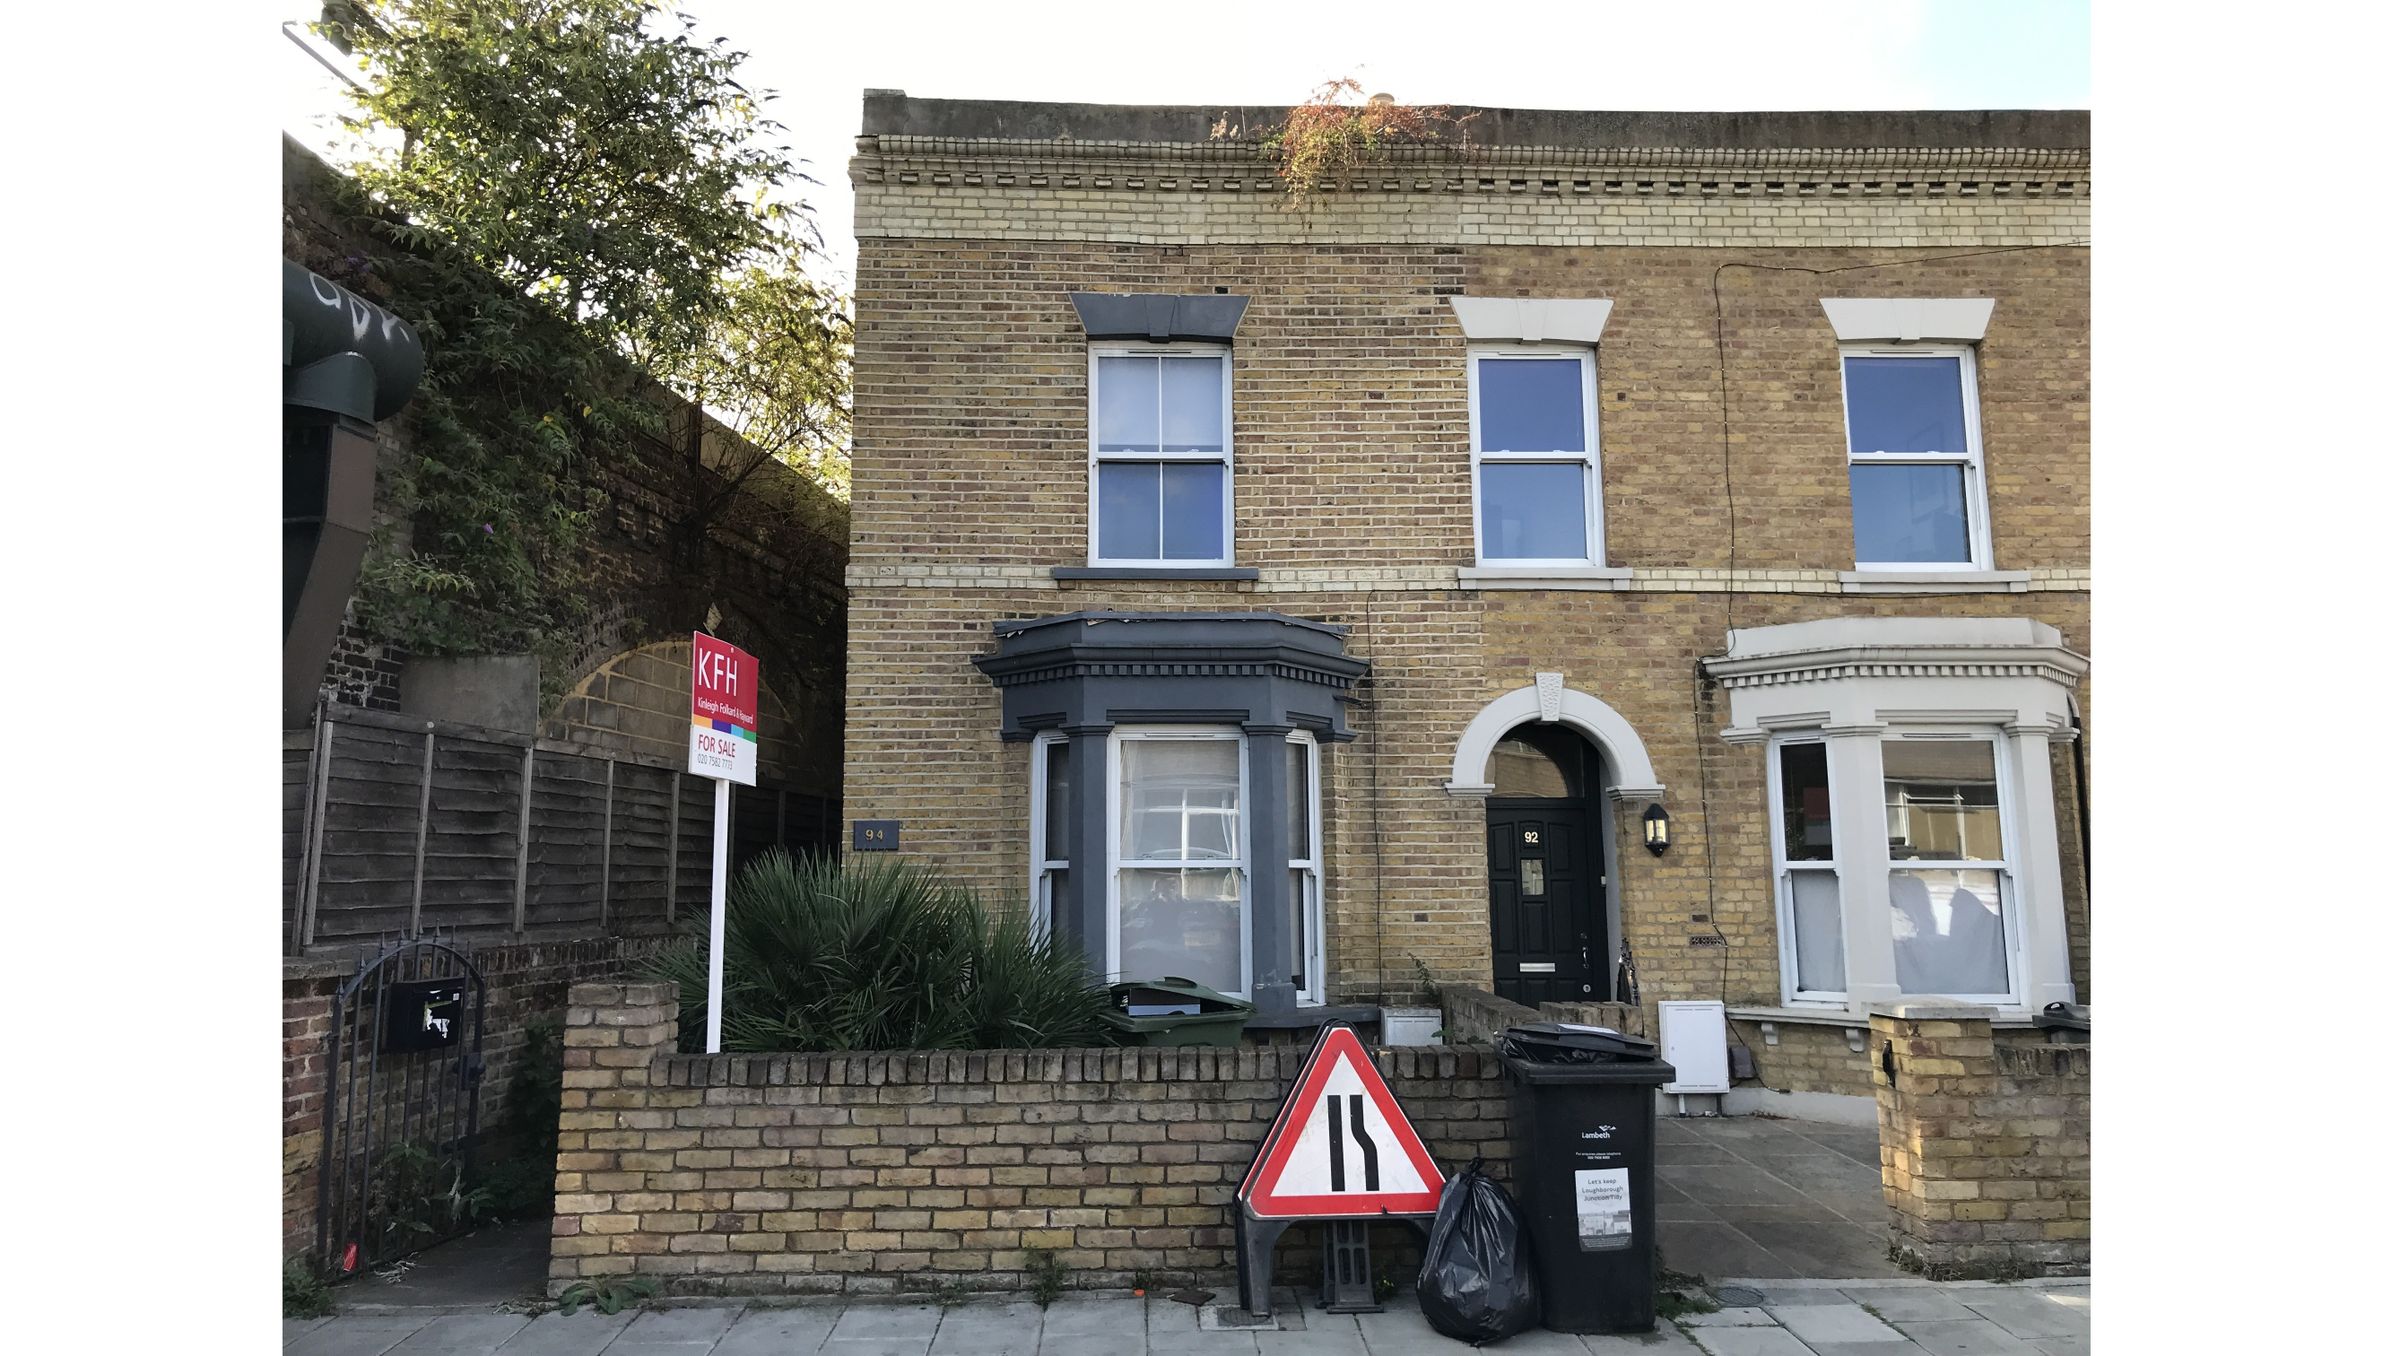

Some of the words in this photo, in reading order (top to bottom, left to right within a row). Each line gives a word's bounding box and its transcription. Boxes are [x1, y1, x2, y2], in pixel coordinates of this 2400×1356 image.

[698, 647, 738, 697] KFH
[698, 734, 716, 753] FOR
[717, 739, 736, 758] SALE
[697, 753, 708, 765] 020
[1523, 831, 1539, 844] 92
[1581, 1131, 1611, 1139] Lambeth
[1581, 1185, 1624, 1194] Loughborough
